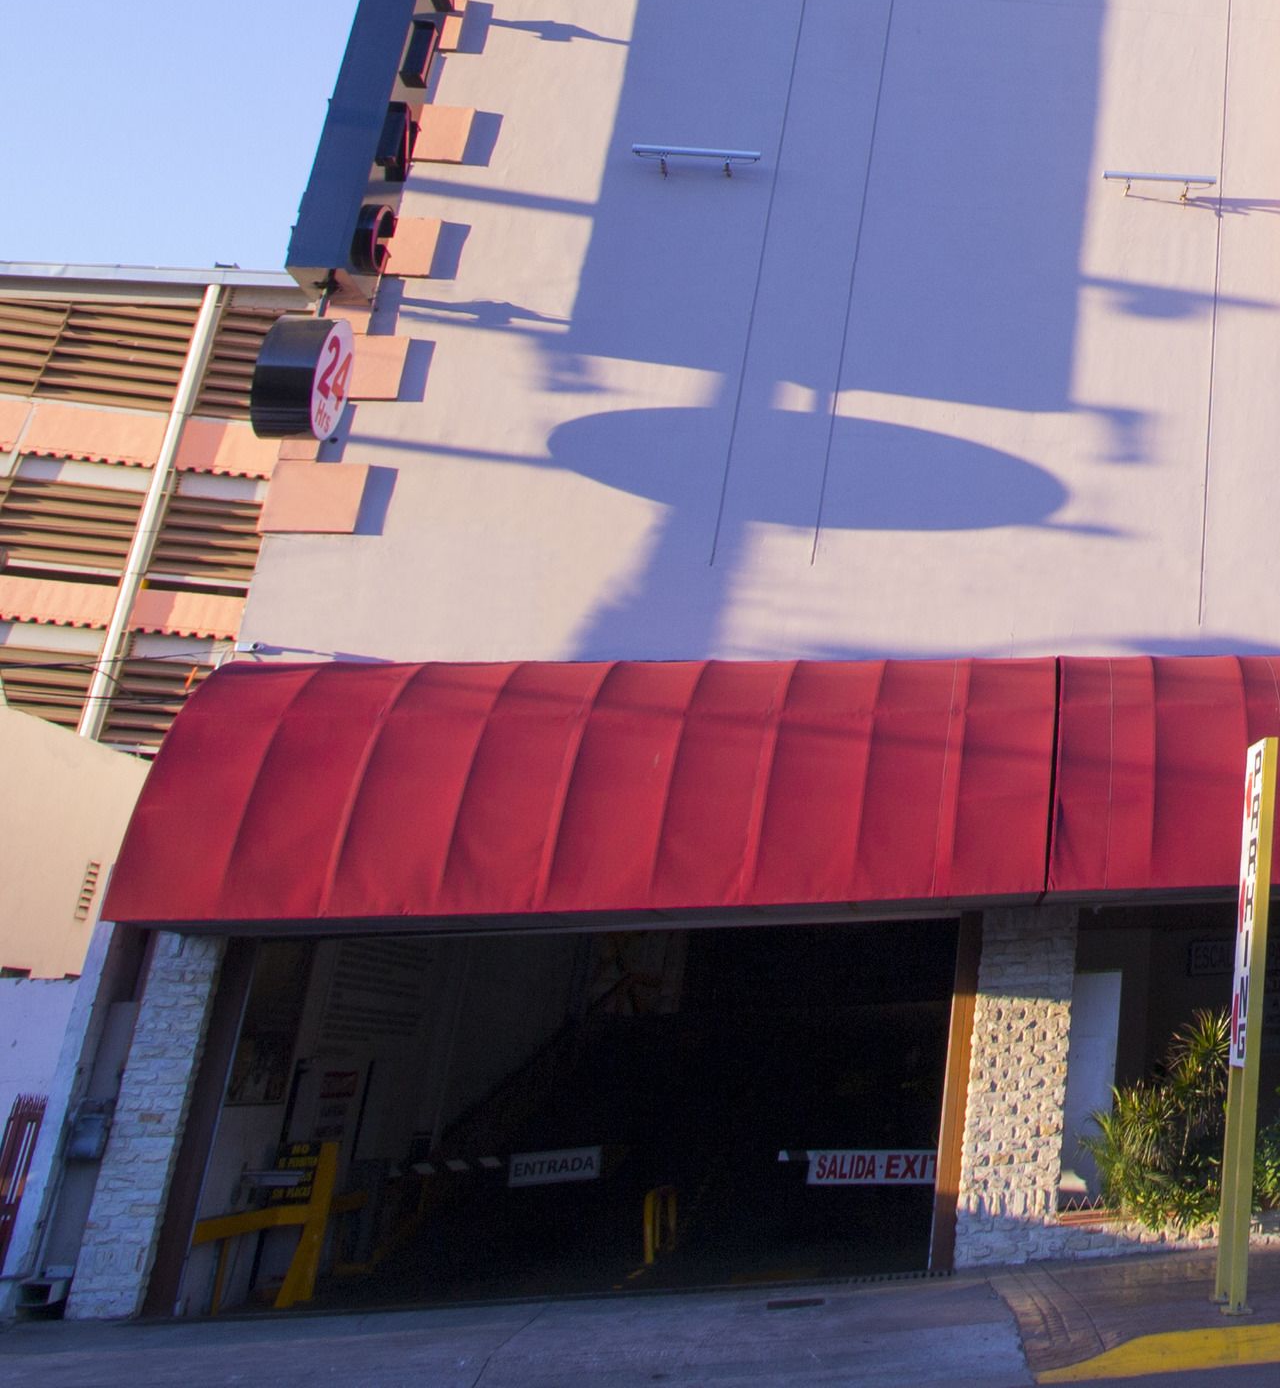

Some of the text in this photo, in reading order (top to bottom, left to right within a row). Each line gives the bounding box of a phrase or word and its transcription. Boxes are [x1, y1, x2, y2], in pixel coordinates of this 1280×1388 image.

[316, 334, 353, 412] 24
[314, 398, 332, 434] Hrs
[1236, 749, 1262, 1060] PARKING
[513, 1156, 595, 1178] ENTRADA
[815, 1154, 876, 1180] SALIDA
